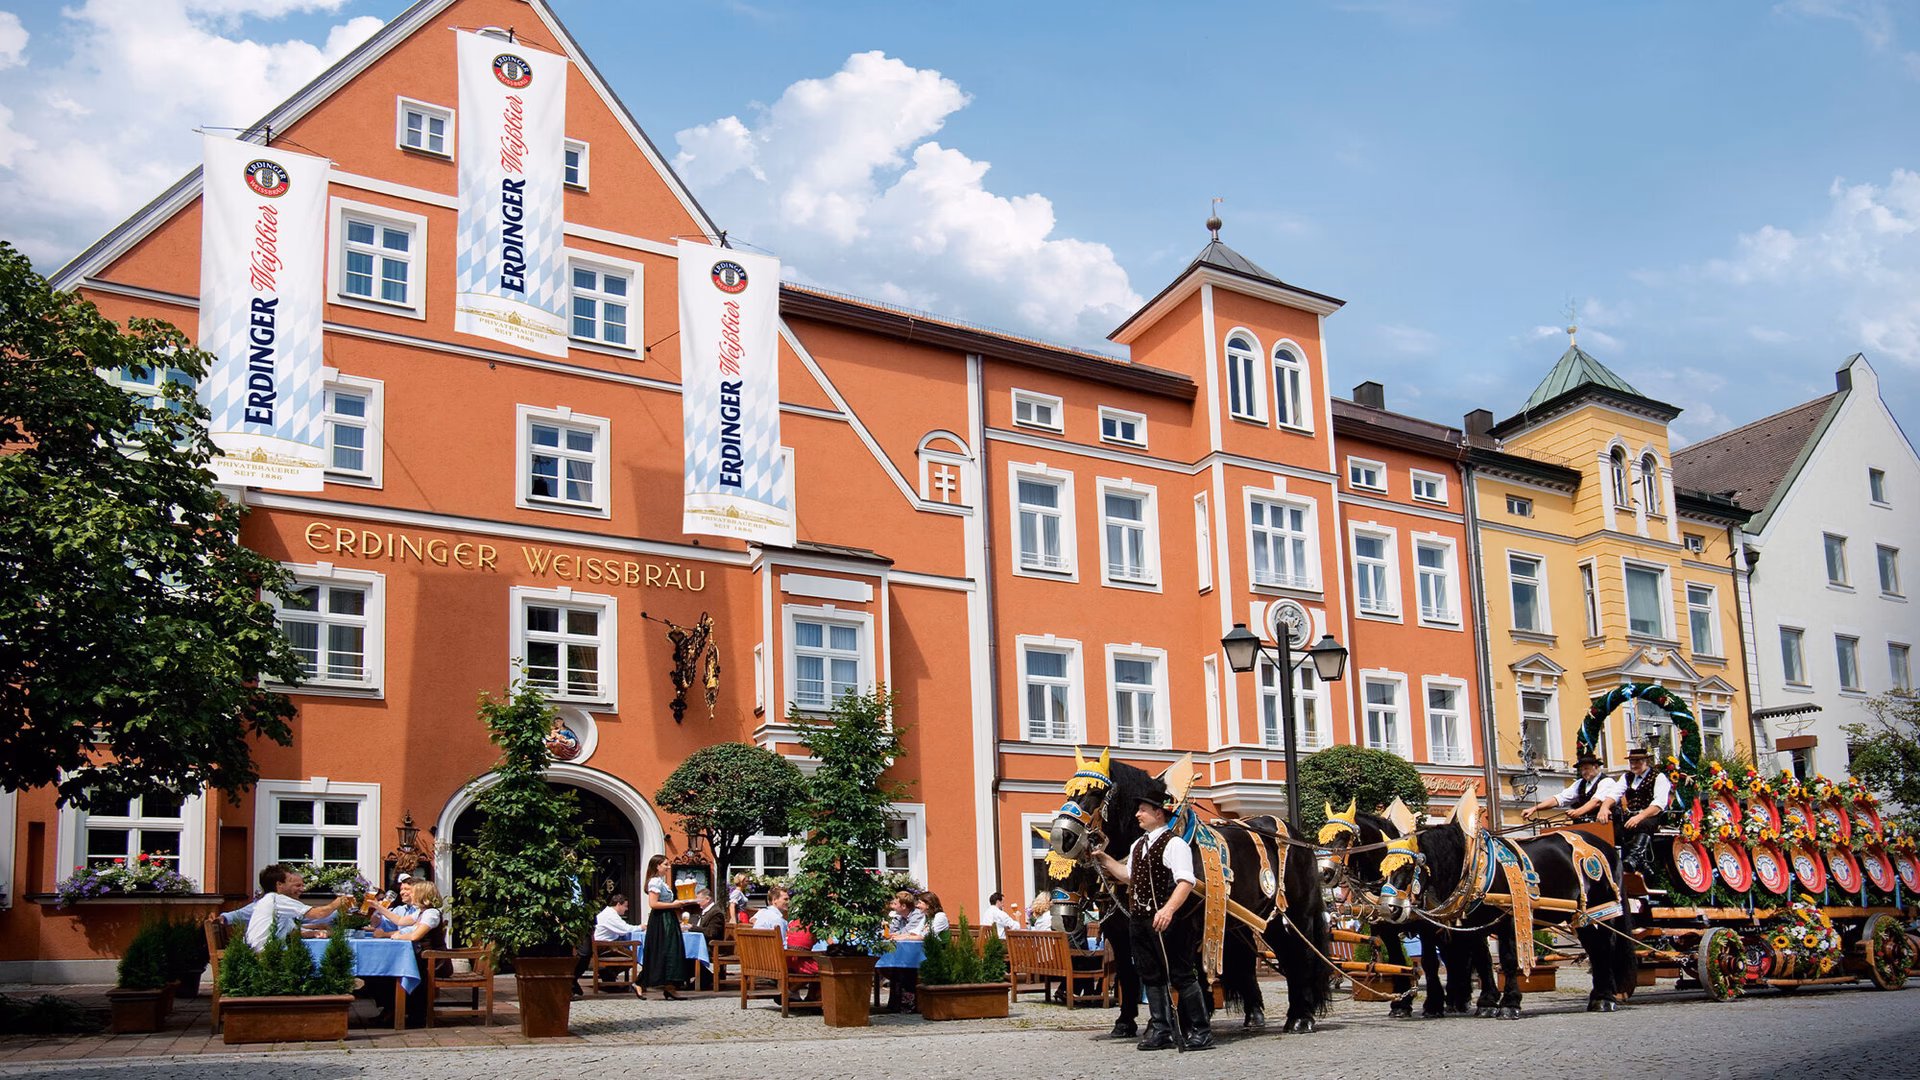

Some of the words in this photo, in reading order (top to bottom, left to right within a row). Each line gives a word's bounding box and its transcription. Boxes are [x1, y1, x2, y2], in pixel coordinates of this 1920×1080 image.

[495, 56, 530, 73] ERDINGER
[248, 161, 287, 180] ERDINGER
[500, 94, 529, 175] Weißbier
[249, 203, 283, 293] Weißbier
[501, 177, 526, 294] ERDINGER
[713, 262, 746, 278] ERDINGER
[244, 297, 279, 427] ERDINGER
[718, 299, 745, 377] Weißbier
[216, 460, 300, 476] PRIVATBRAUEREI
[720, 380, 743, 489] ERDINGER
[233, 470, 257, 478] SEIT
[305, 522, 498, 569] ERDINGER
[521, 546, 707, 592] WEISSBRÄU
